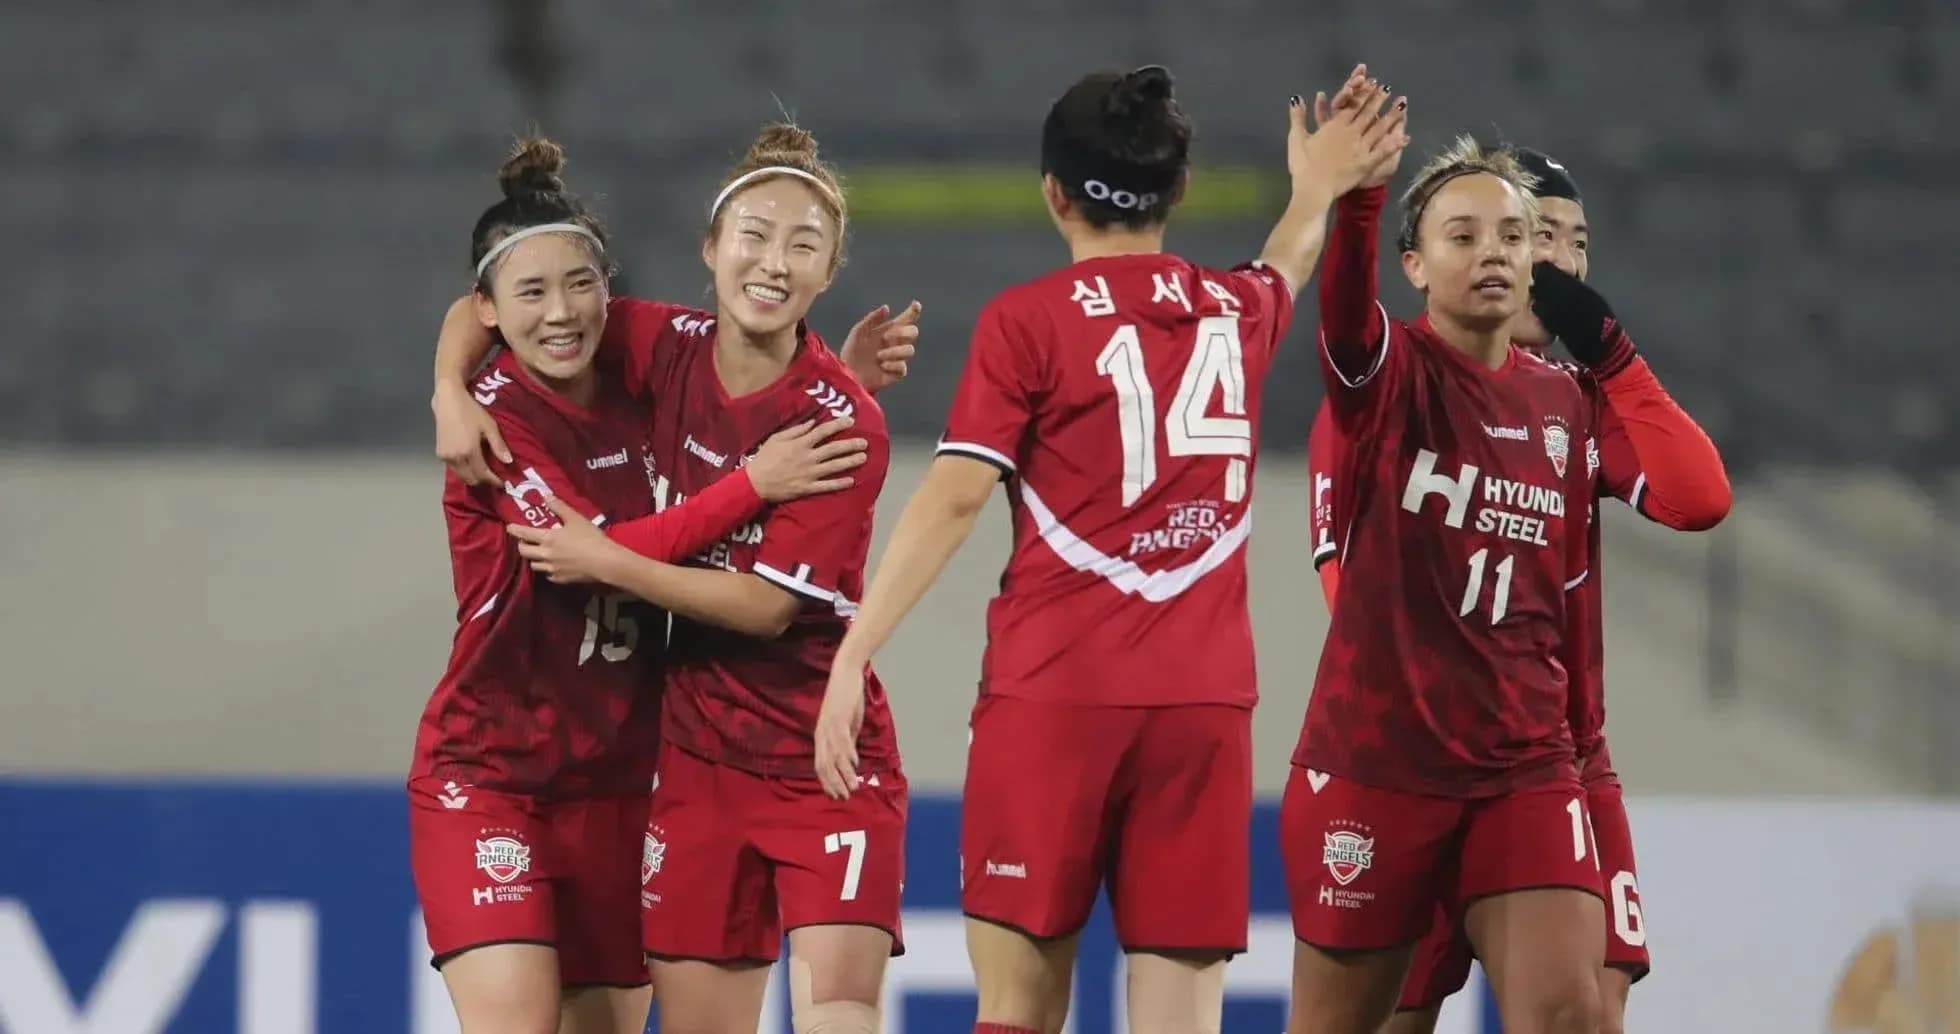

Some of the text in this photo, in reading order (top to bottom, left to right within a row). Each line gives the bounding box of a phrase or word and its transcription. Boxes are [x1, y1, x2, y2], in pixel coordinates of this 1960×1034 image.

[1096, 317, 1251, 507] 14
[585, 448, 628, 470] ummel
[1484, 476, 1565, 518] HYUND
[1168, 507, 1217, 528] RED
[1475, 508, 1548, 546] STEEL
[1460, 548, 1514, 625] 11
[578, 593, 639, 666] 15
[494, 845, 515, 856] RED
[1337, 841, 1356, 852] RED
[479, 854, 528, 870] ANGELS
[824, 830, 866, 900] 7
[1326, 849, 1370, 867] ANGELS
[496, 893, 525, 902] STEEL
[1335, 889, 1375, 901] HYUNDAI
[1335, 898, 1362, 909] STEEL
